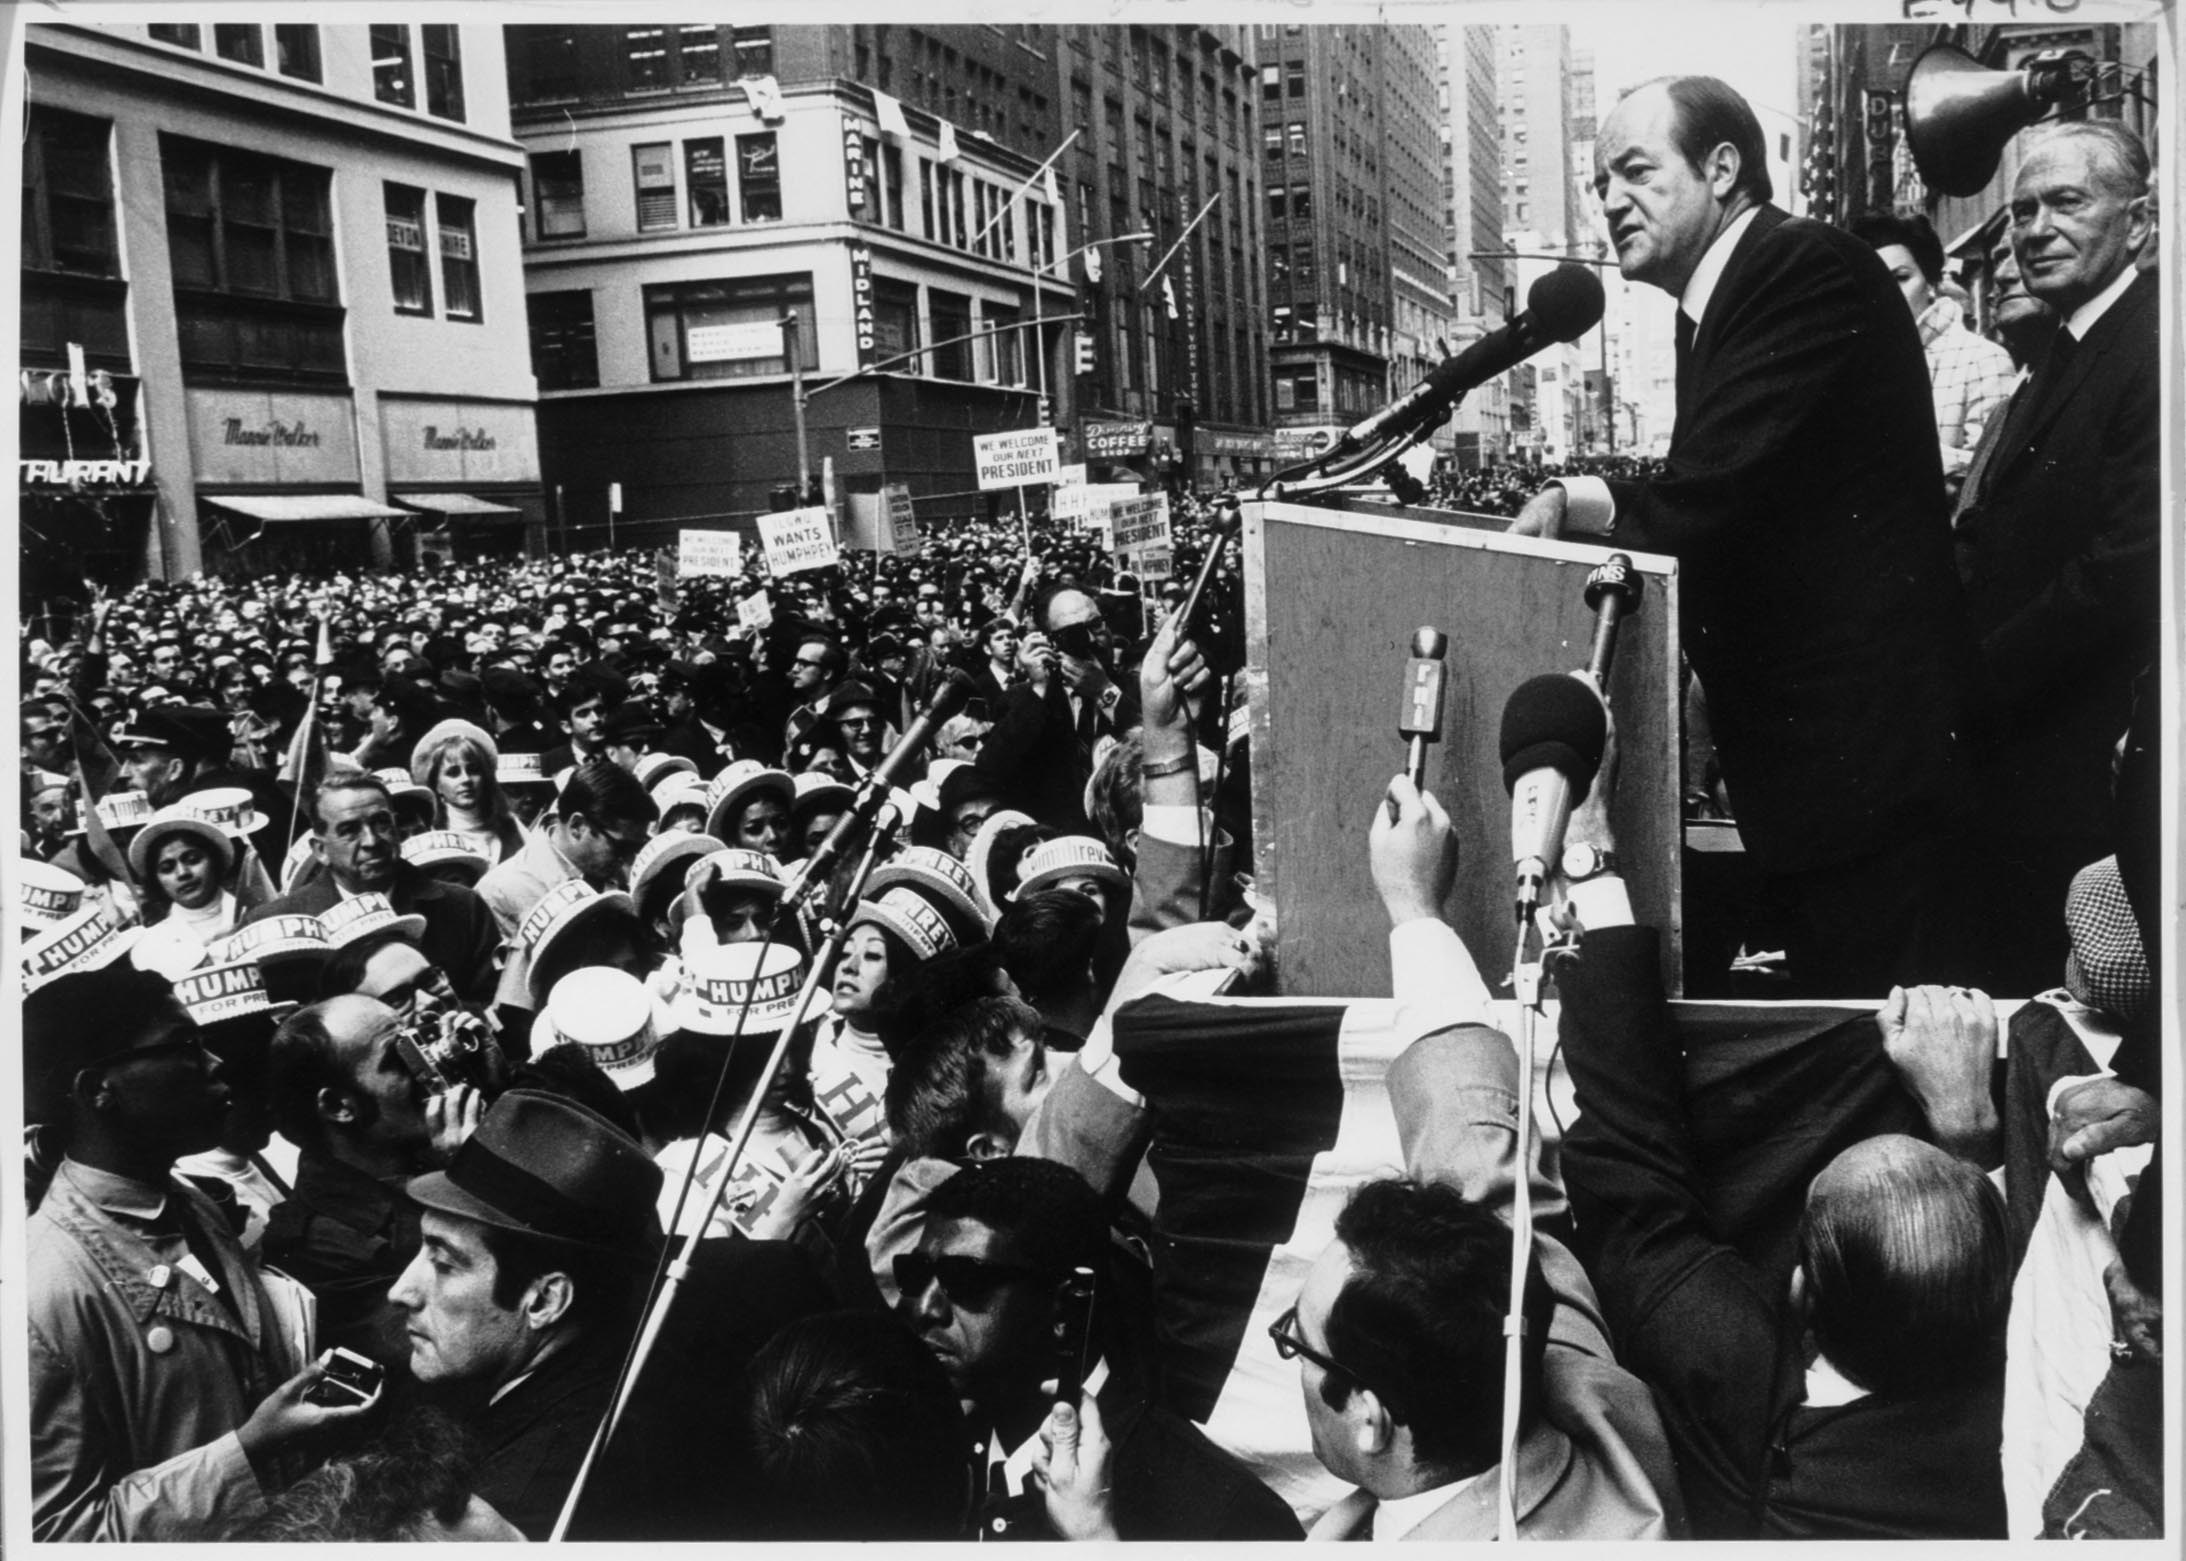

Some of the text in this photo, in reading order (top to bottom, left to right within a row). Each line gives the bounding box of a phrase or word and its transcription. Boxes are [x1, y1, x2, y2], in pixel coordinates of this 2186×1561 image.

[843, 117, 864, 204] MARINE
[852, 248, 874, 349] MIDLAND
[980, 434, 1049, 452] WE WELCOME
[1087, 435, 1147, 449] COFFEE
[992, 446, 1044, 463] OUR NEXT
[981, 458, 1053, 480] PRESIDENT
[773, 527, 822, 548] WANTS
[682, 555, 734, 569] PRESIDENT
[200, 1000, 240, 1014] FOR
